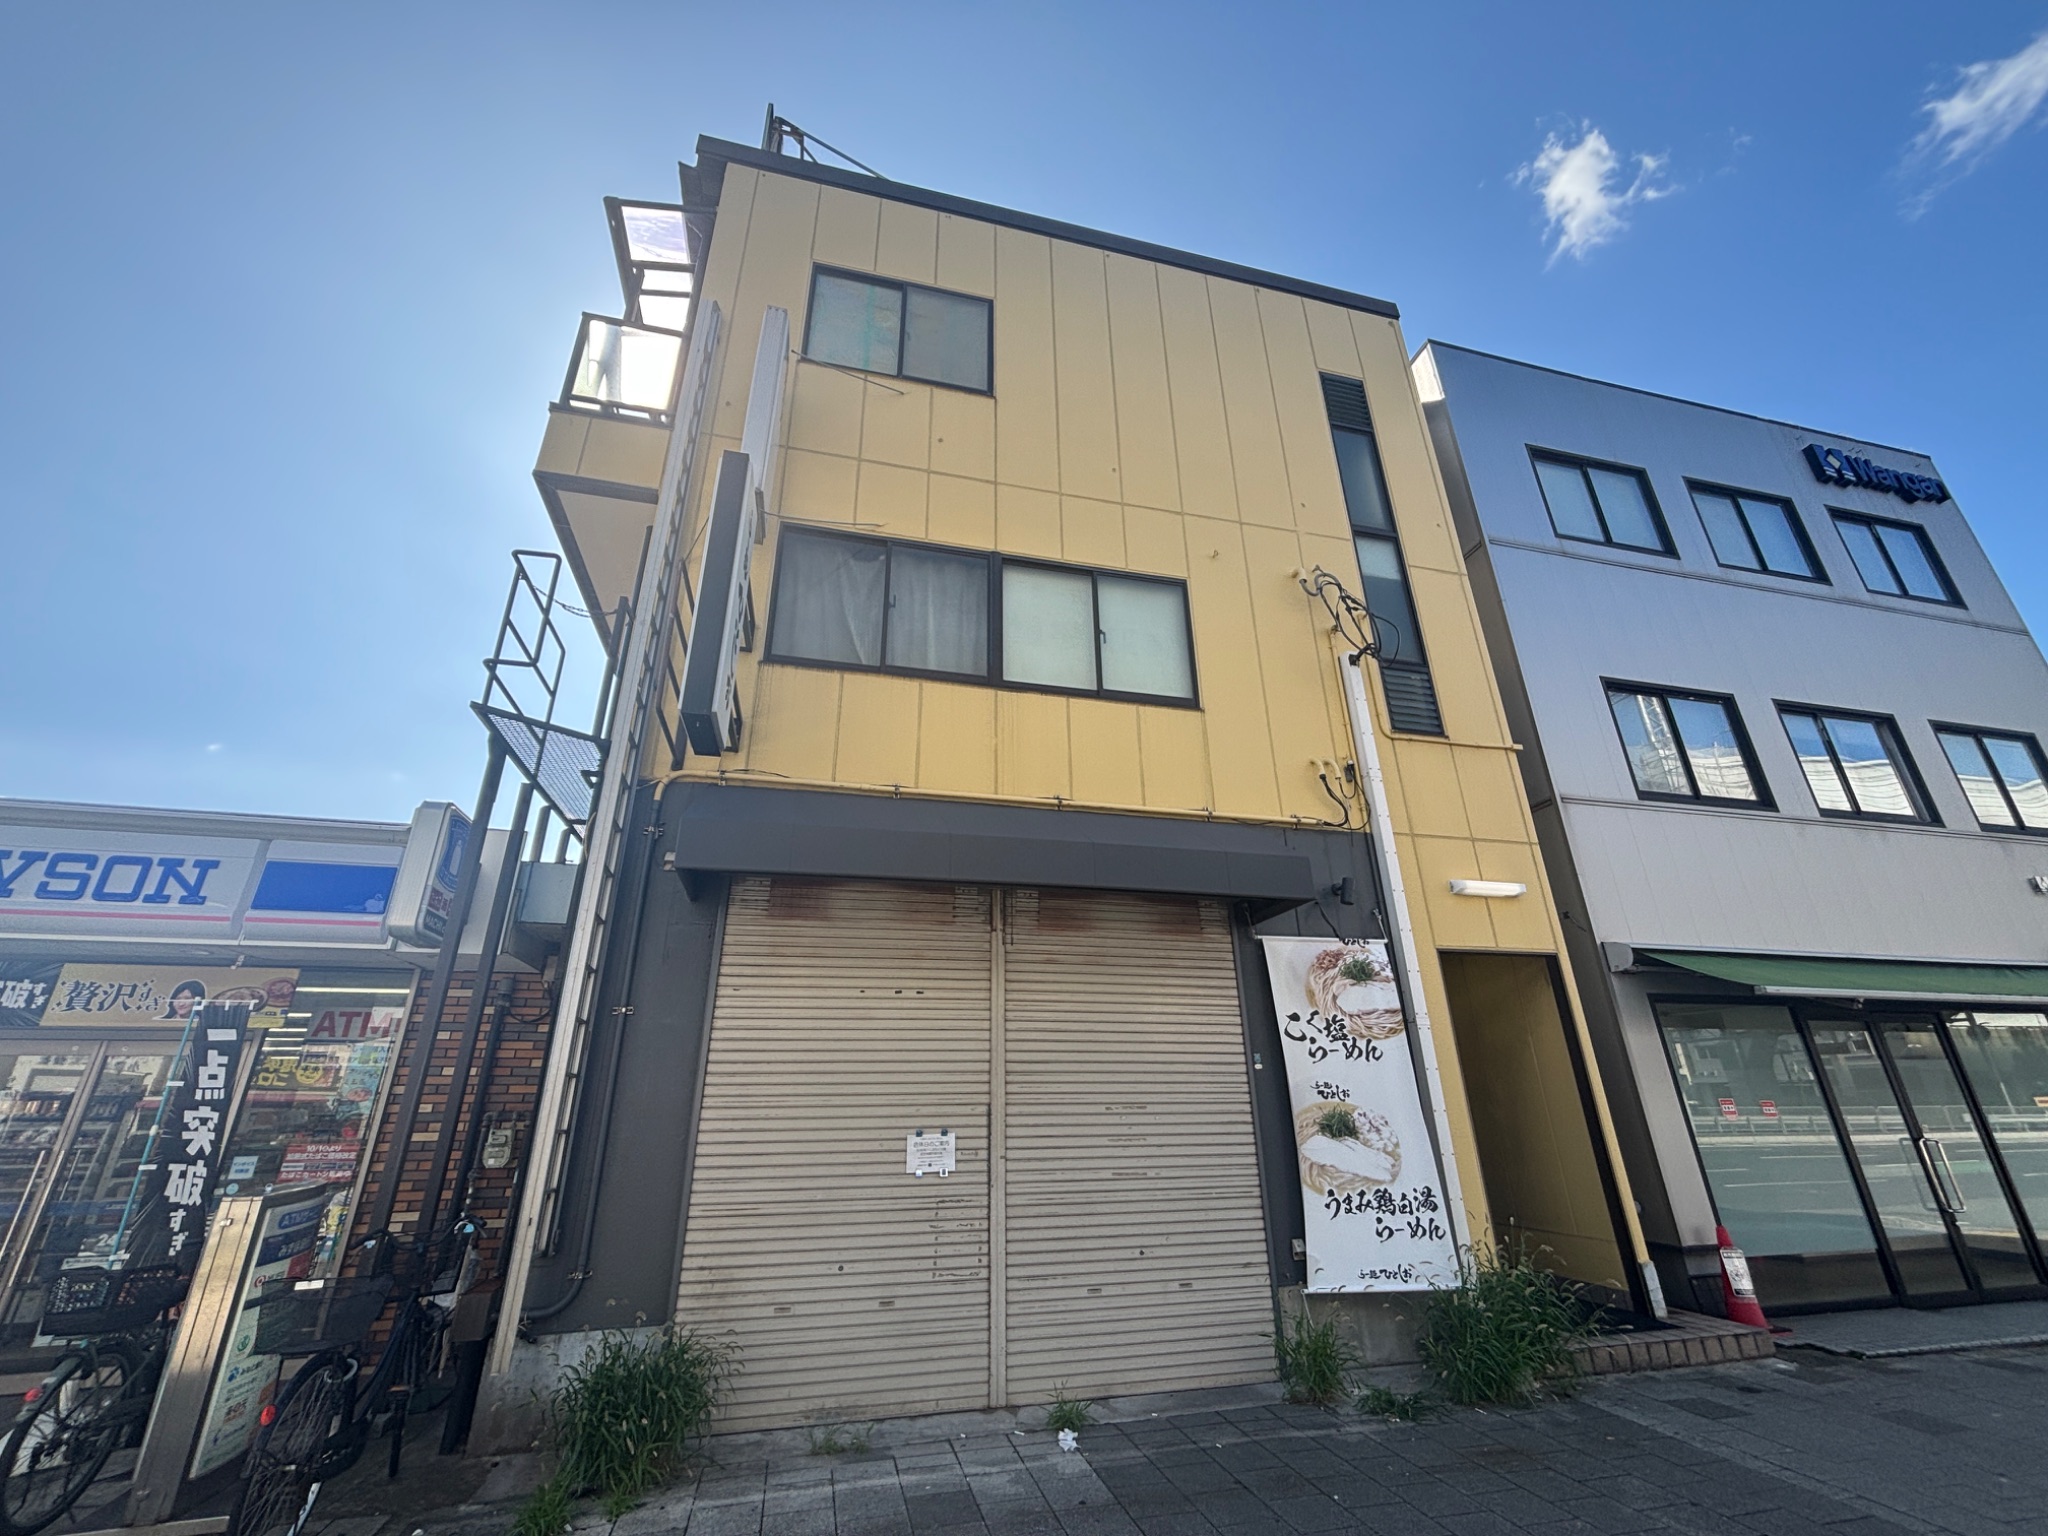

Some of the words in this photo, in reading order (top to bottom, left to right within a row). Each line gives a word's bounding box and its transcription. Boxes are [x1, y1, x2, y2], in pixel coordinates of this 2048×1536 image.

[1845, 454, 1949, 502] Wangan
[0, 979, 48, 1009] 破すぎ
[60, 980, 165, 1012] 贅沢すぎ
[1284, 1010, 1350, 1043] こく塩
[1308, 1036, 1384, 1064] らーめん
[163, 1028, 238, 1256] 一点突破すぎ
[1324, 1186, 1439, 1220] うまみ鶏白湯
[1375, 1216, 1446, 1243] らーめん
